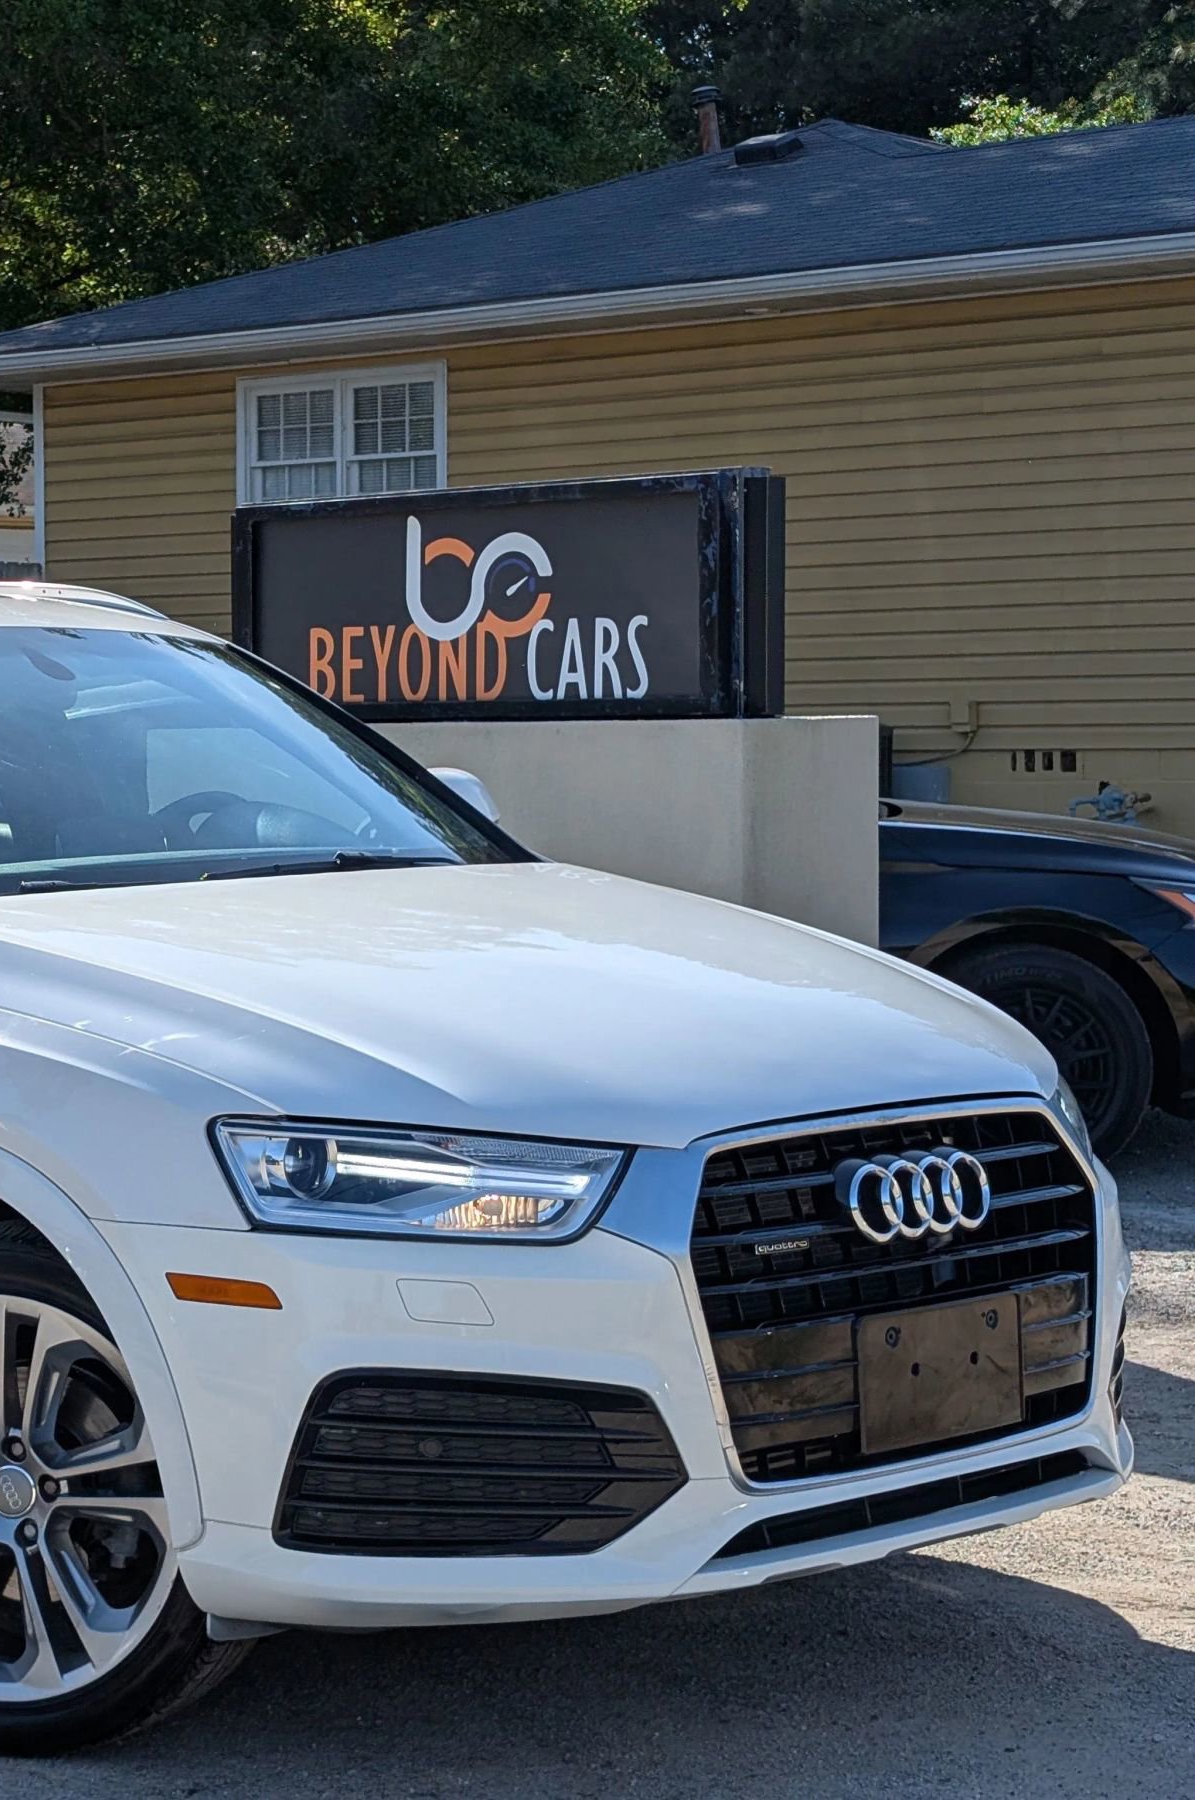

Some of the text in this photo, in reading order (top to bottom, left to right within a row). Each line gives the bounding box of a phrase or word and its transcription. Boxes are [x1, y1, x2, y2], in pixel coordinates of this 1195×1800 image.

[309, 614, 649, 703] BEYOND CARS
[758, 1240, 808, 1255] quattro
